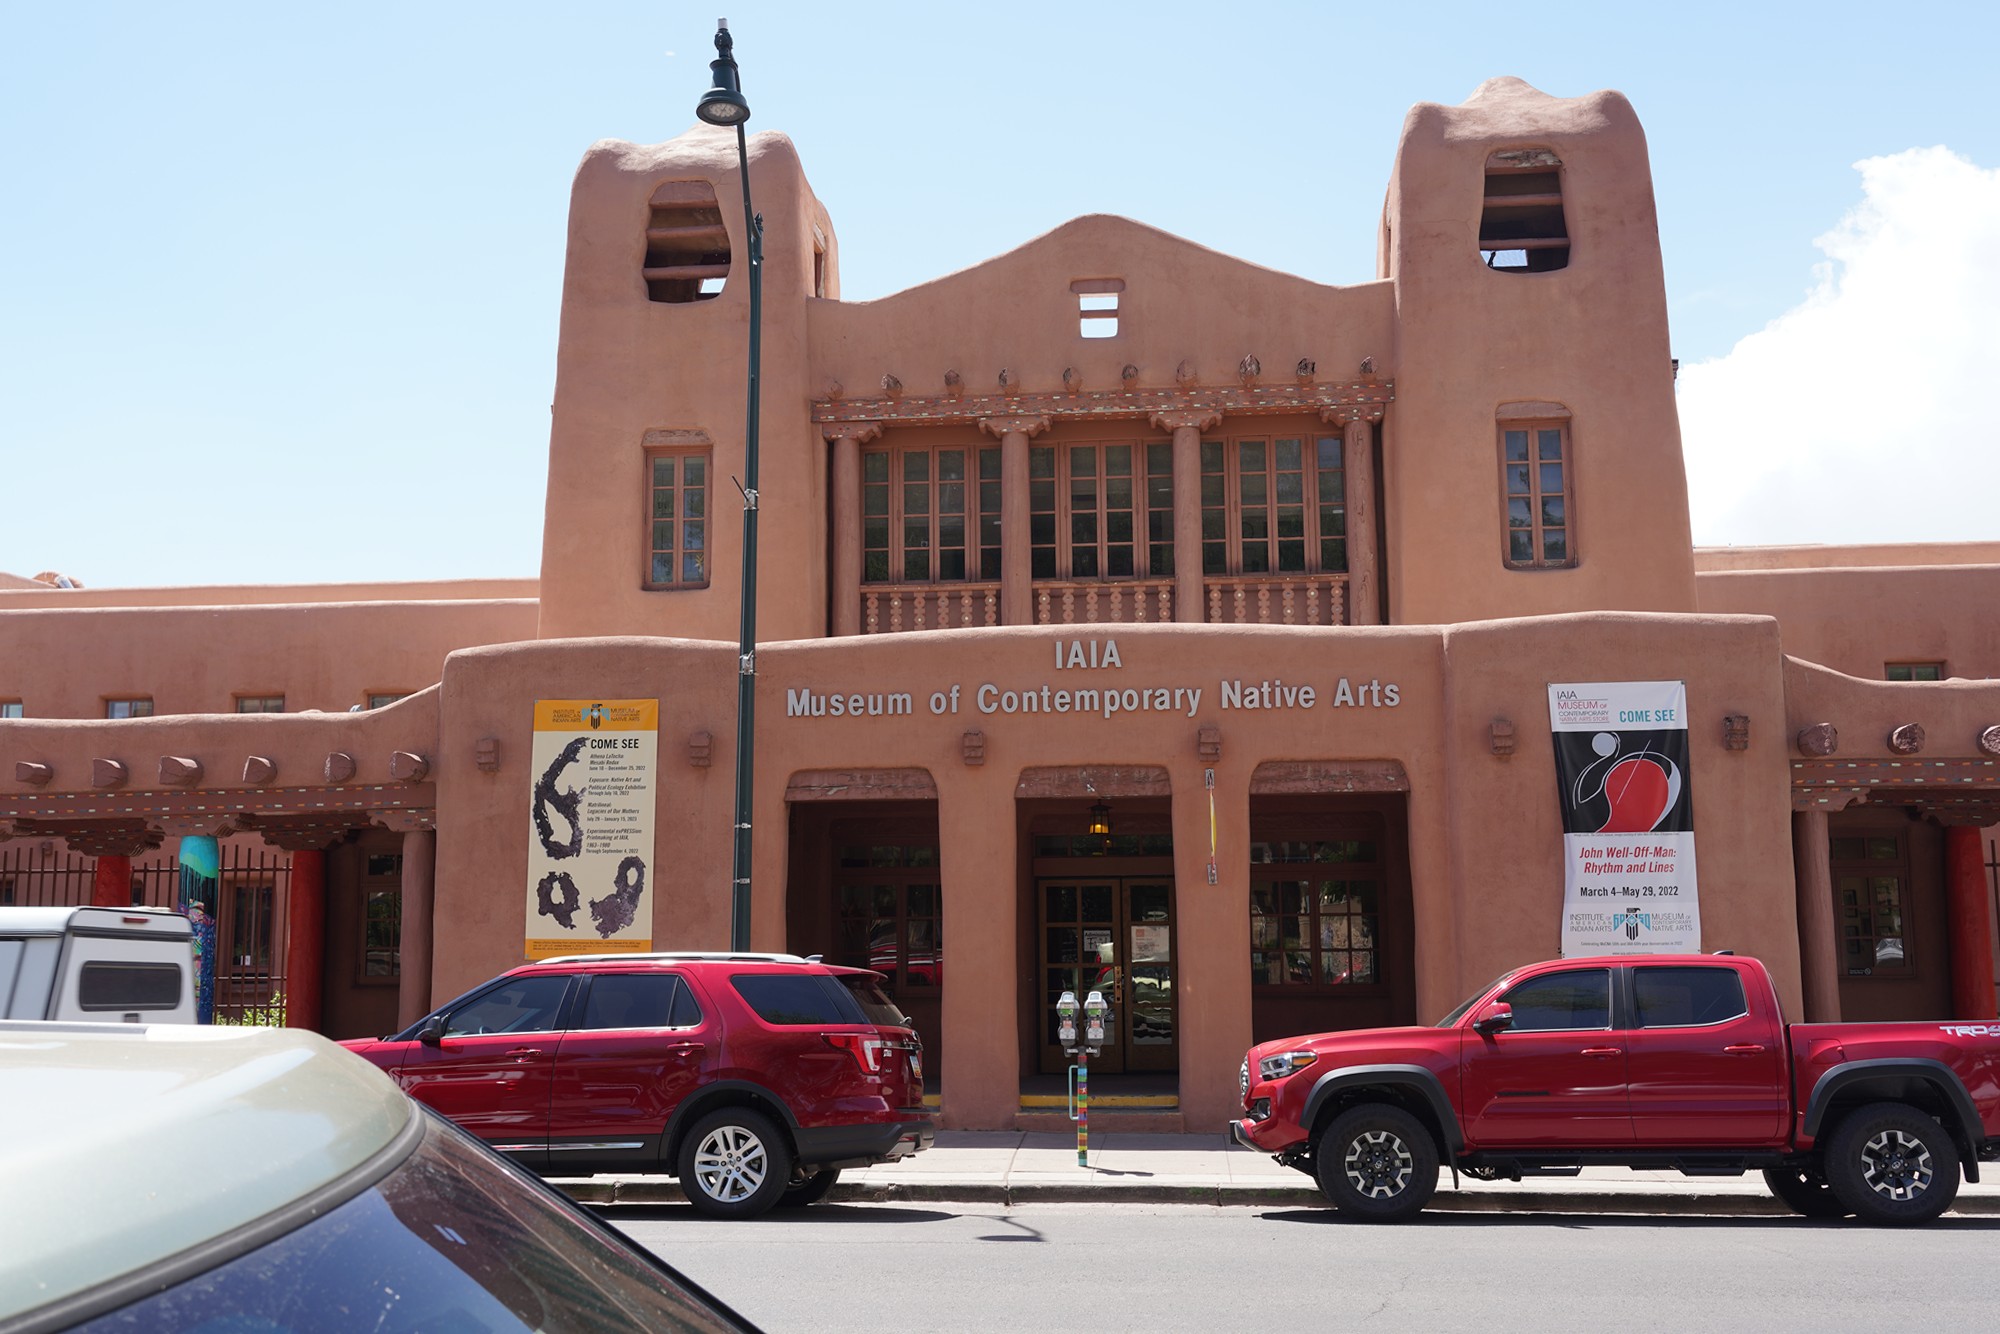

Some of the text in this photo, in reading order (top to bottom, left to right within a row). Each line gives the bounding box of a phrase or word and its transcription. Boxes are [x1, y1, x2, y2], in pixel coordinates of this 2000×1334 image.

[1055, 640, 1122, 670] IAIA
[787, 678, 1401, 719] Museum of Contemporary Native Arts
[1557, 690, 1578, 700] IAIA
[1558, 701, 1598, 710] MUSEUM
[1620, 710, 1675, 723] COME SEE
[591, 739, 639, 749] COME SEE
[1580, 846, 1676, 858] John Well-Off-Man:
[1584, 862, 1674, 876] Rhythm and Lines
[1580, 887, 1608, 896] March
[1642, 886, 1656, 897] 29,
[1659, 886, 1679, 896] 2022
[1939, 1025, 1988, 1037] TRD
